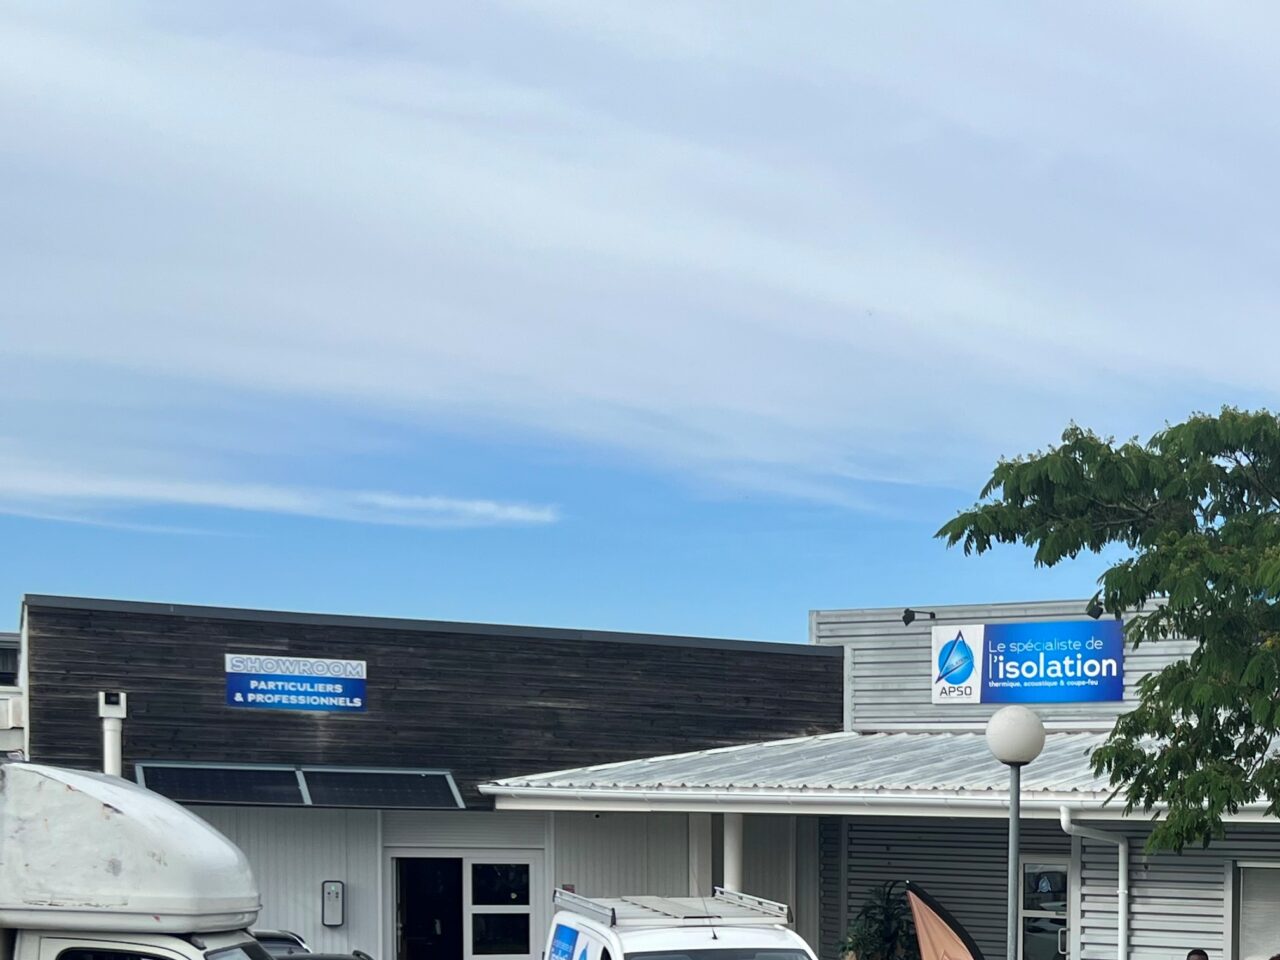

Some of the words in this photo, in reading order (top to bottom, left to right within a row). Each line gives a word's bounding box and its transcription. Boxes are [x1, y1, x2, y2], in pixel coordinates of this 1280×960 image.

[989, 640, 1006, 653] Le
[1009, 638, 1082, 654] spécialiste
[1085, 635, 1104, 650] de
[231, 656, 364, 677] SHOWROOM
[988, 652, 1117, 679] l'isolation
[249, 680, 343, 694] PARTICULIERS
[939, 686, 973, 697] APSO
[988, 680, 1022, 689] thermique,
[1023, 679, 1058, 688] acoustique
[1066, 678, 1099, 687] coupe-feu
[233, 692, 244, 703] &
[247, 693, 362, 708] PROFESSIONNELS
